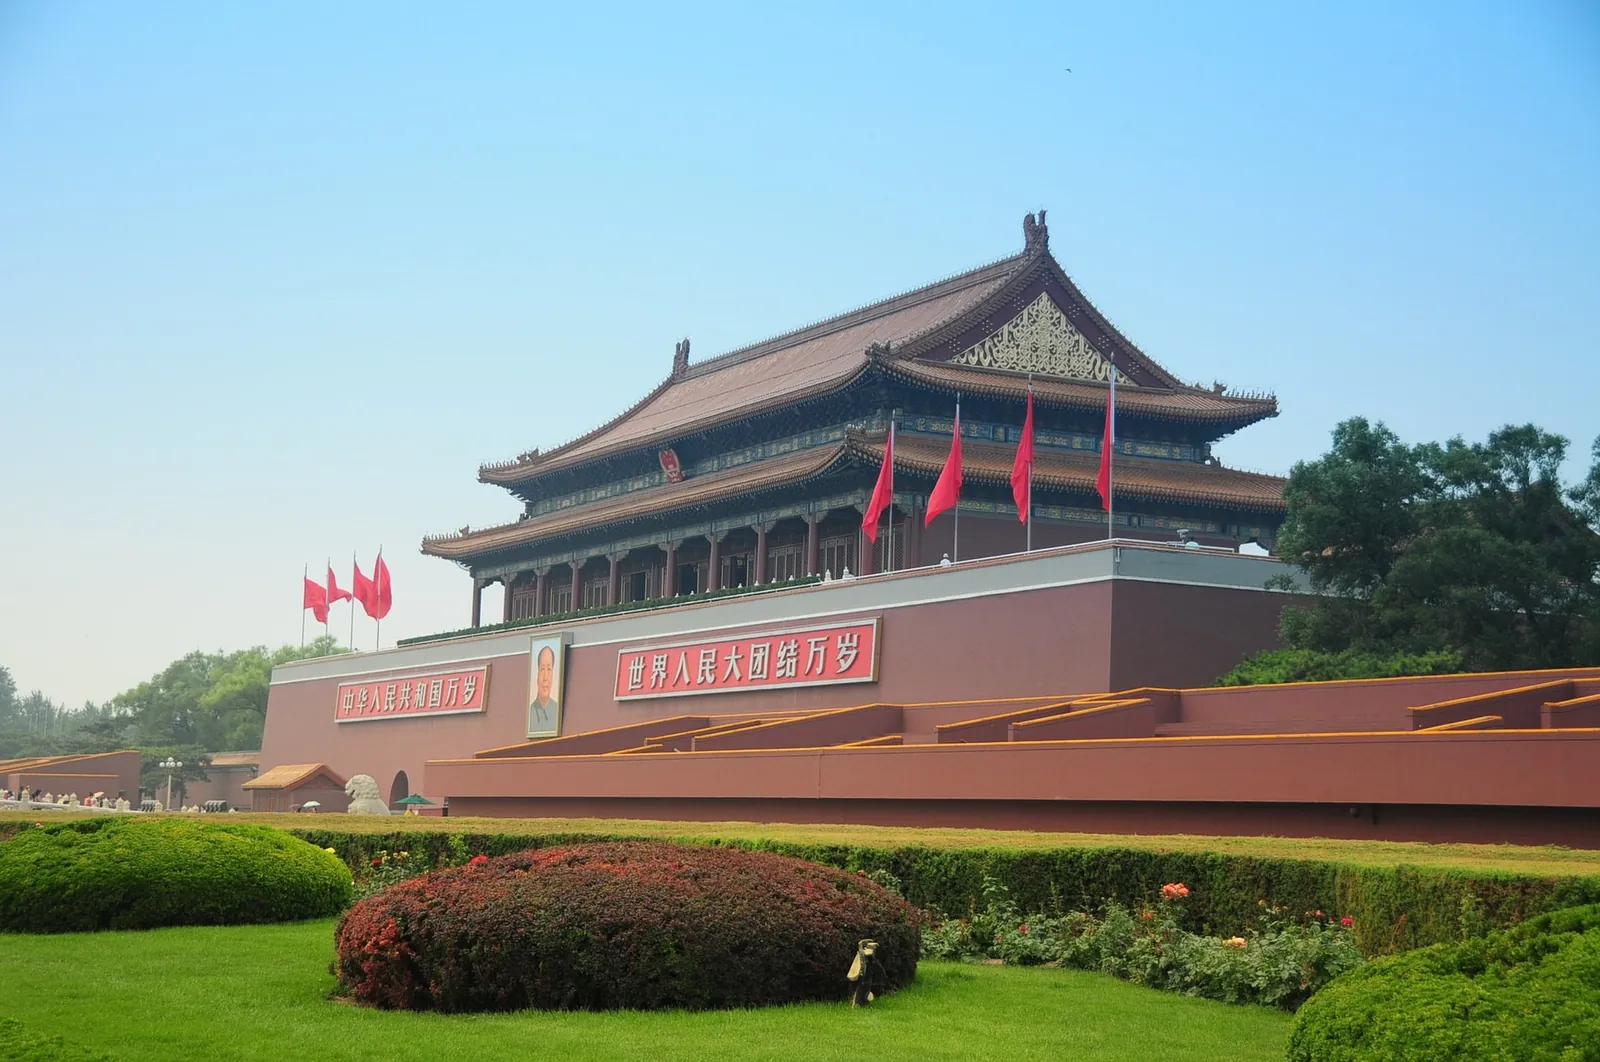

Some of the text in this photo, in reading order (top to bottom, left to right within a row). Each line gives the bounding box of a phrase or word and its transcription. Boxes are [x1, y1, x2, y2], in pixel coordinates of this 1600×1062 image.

[628, 633, 860, 691] 世界人民大团结万岁
[342, 676, 477, 715] 中华人民共和国万岁
